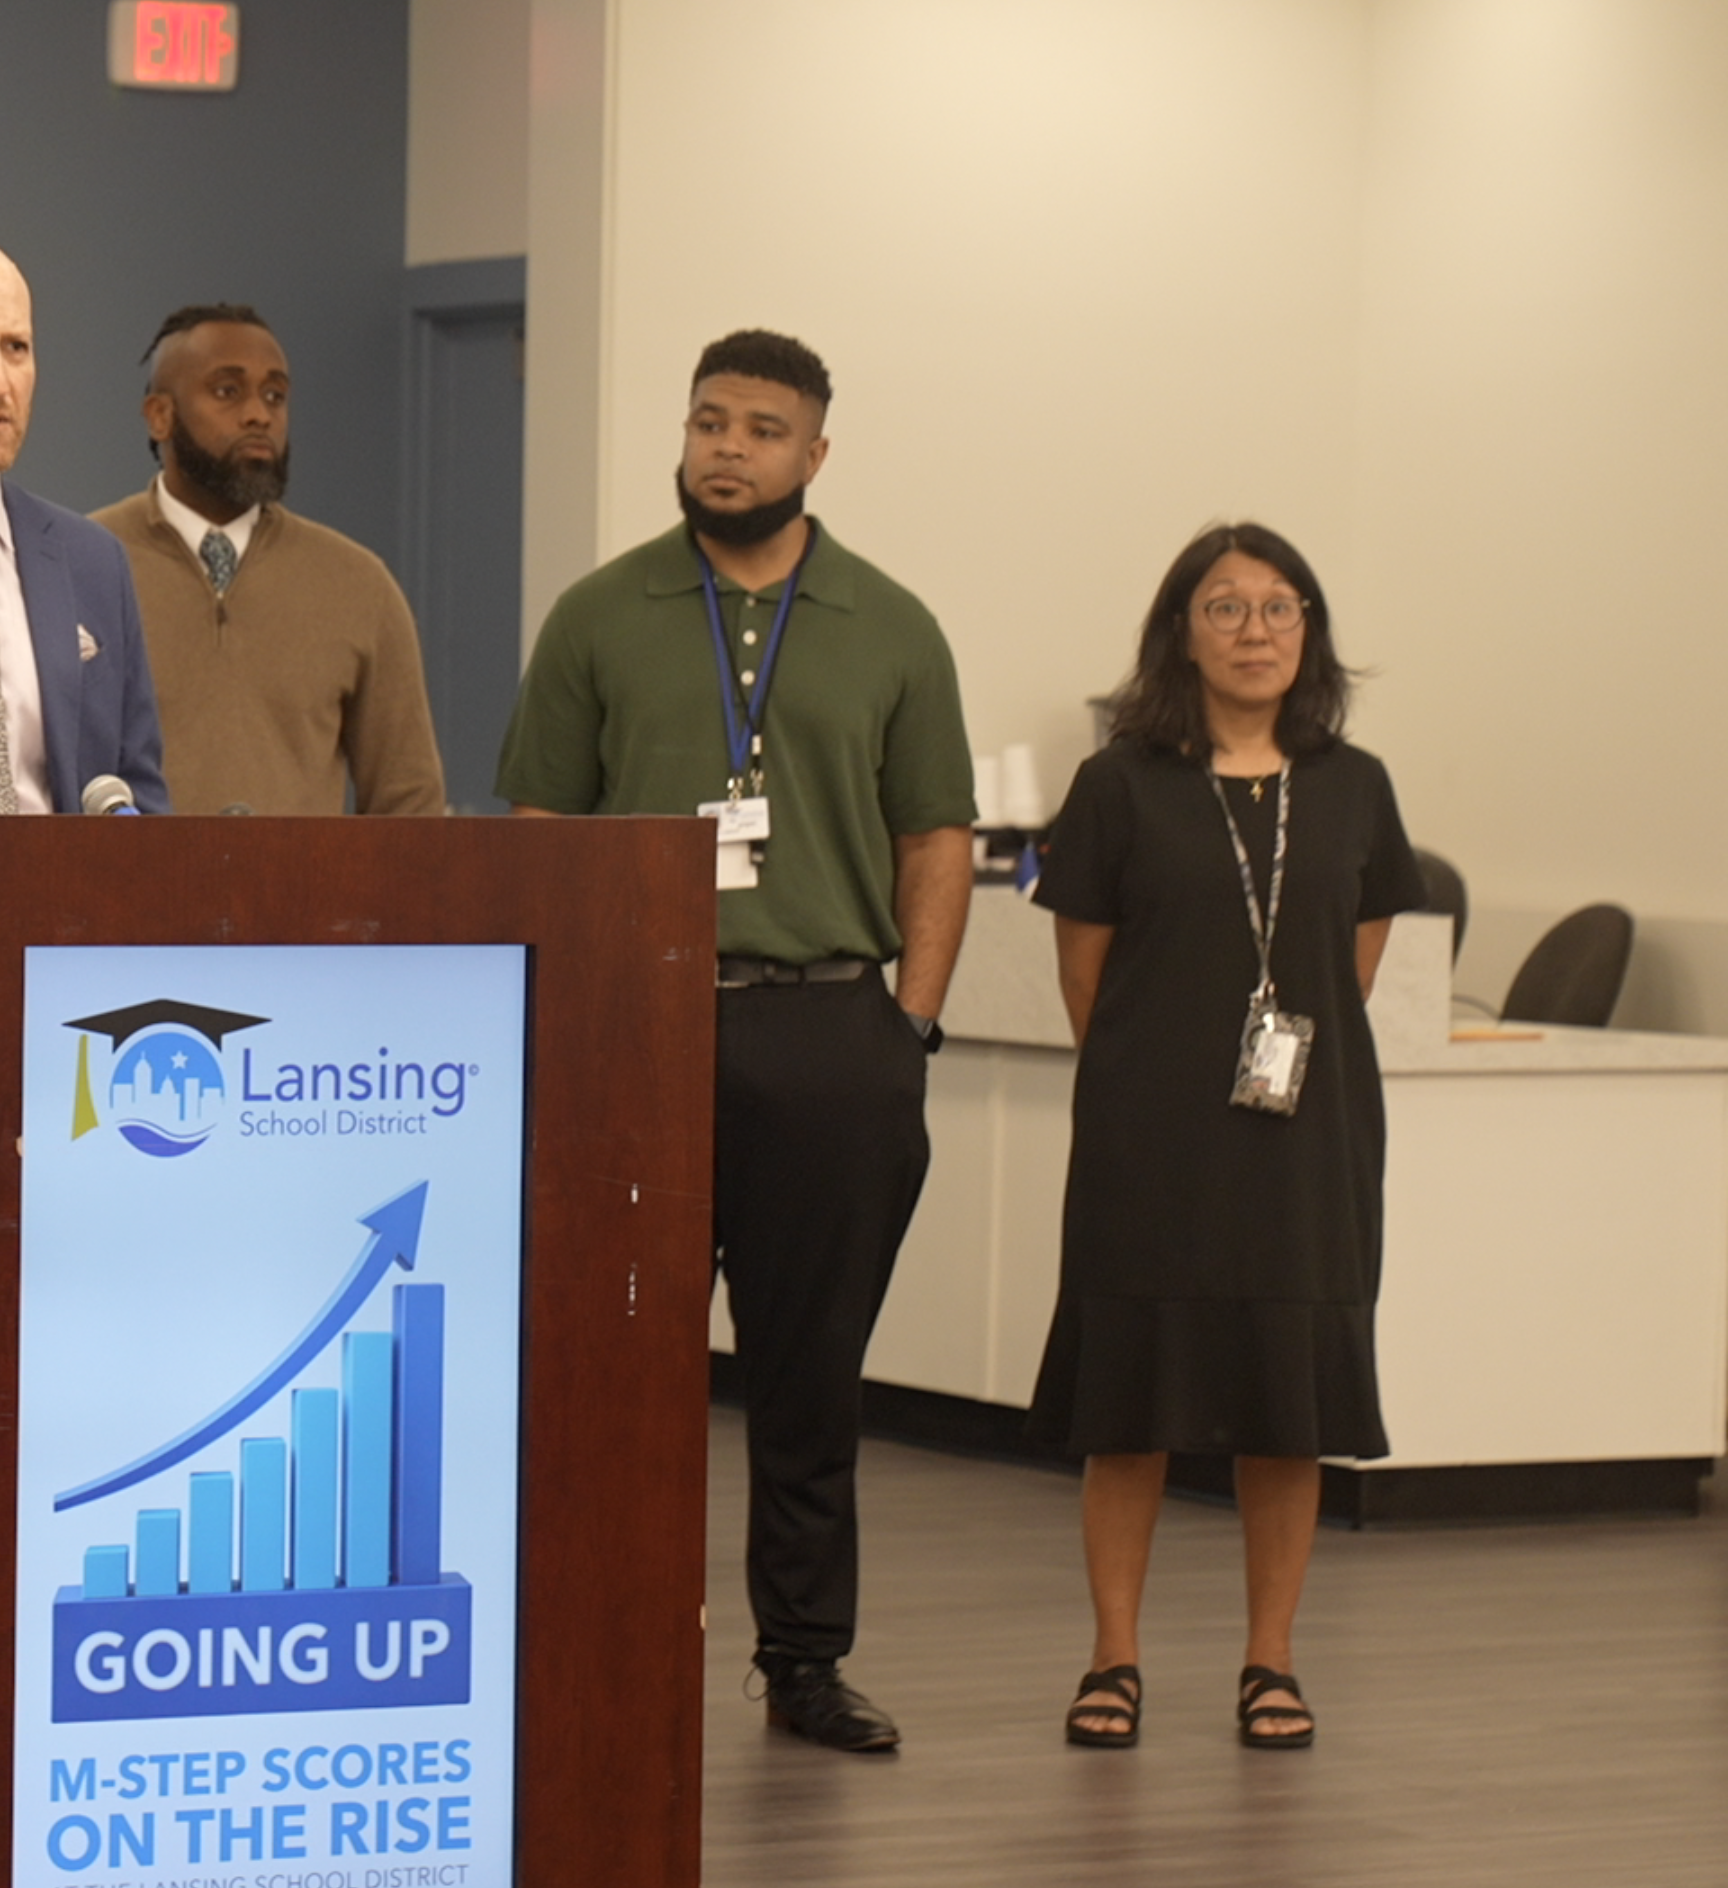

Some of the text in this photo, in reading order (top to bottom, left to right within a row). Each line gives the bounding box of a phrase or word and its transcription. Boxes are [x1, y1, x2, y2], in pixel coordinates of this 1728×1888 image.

[134, 0, 228, 83] EXIT
[240, 1109, 426, 1136] School District
[75, 1619, 450, 1694] GOING UP
[49, 1739, 471, 1802] M-STEP SCORES
[46, 1796, 471, 1872] ON THE RISE
[255, 1870, 352, 1888] SCHOOL
[365, 1864, 469, 1888] DISTRICT
